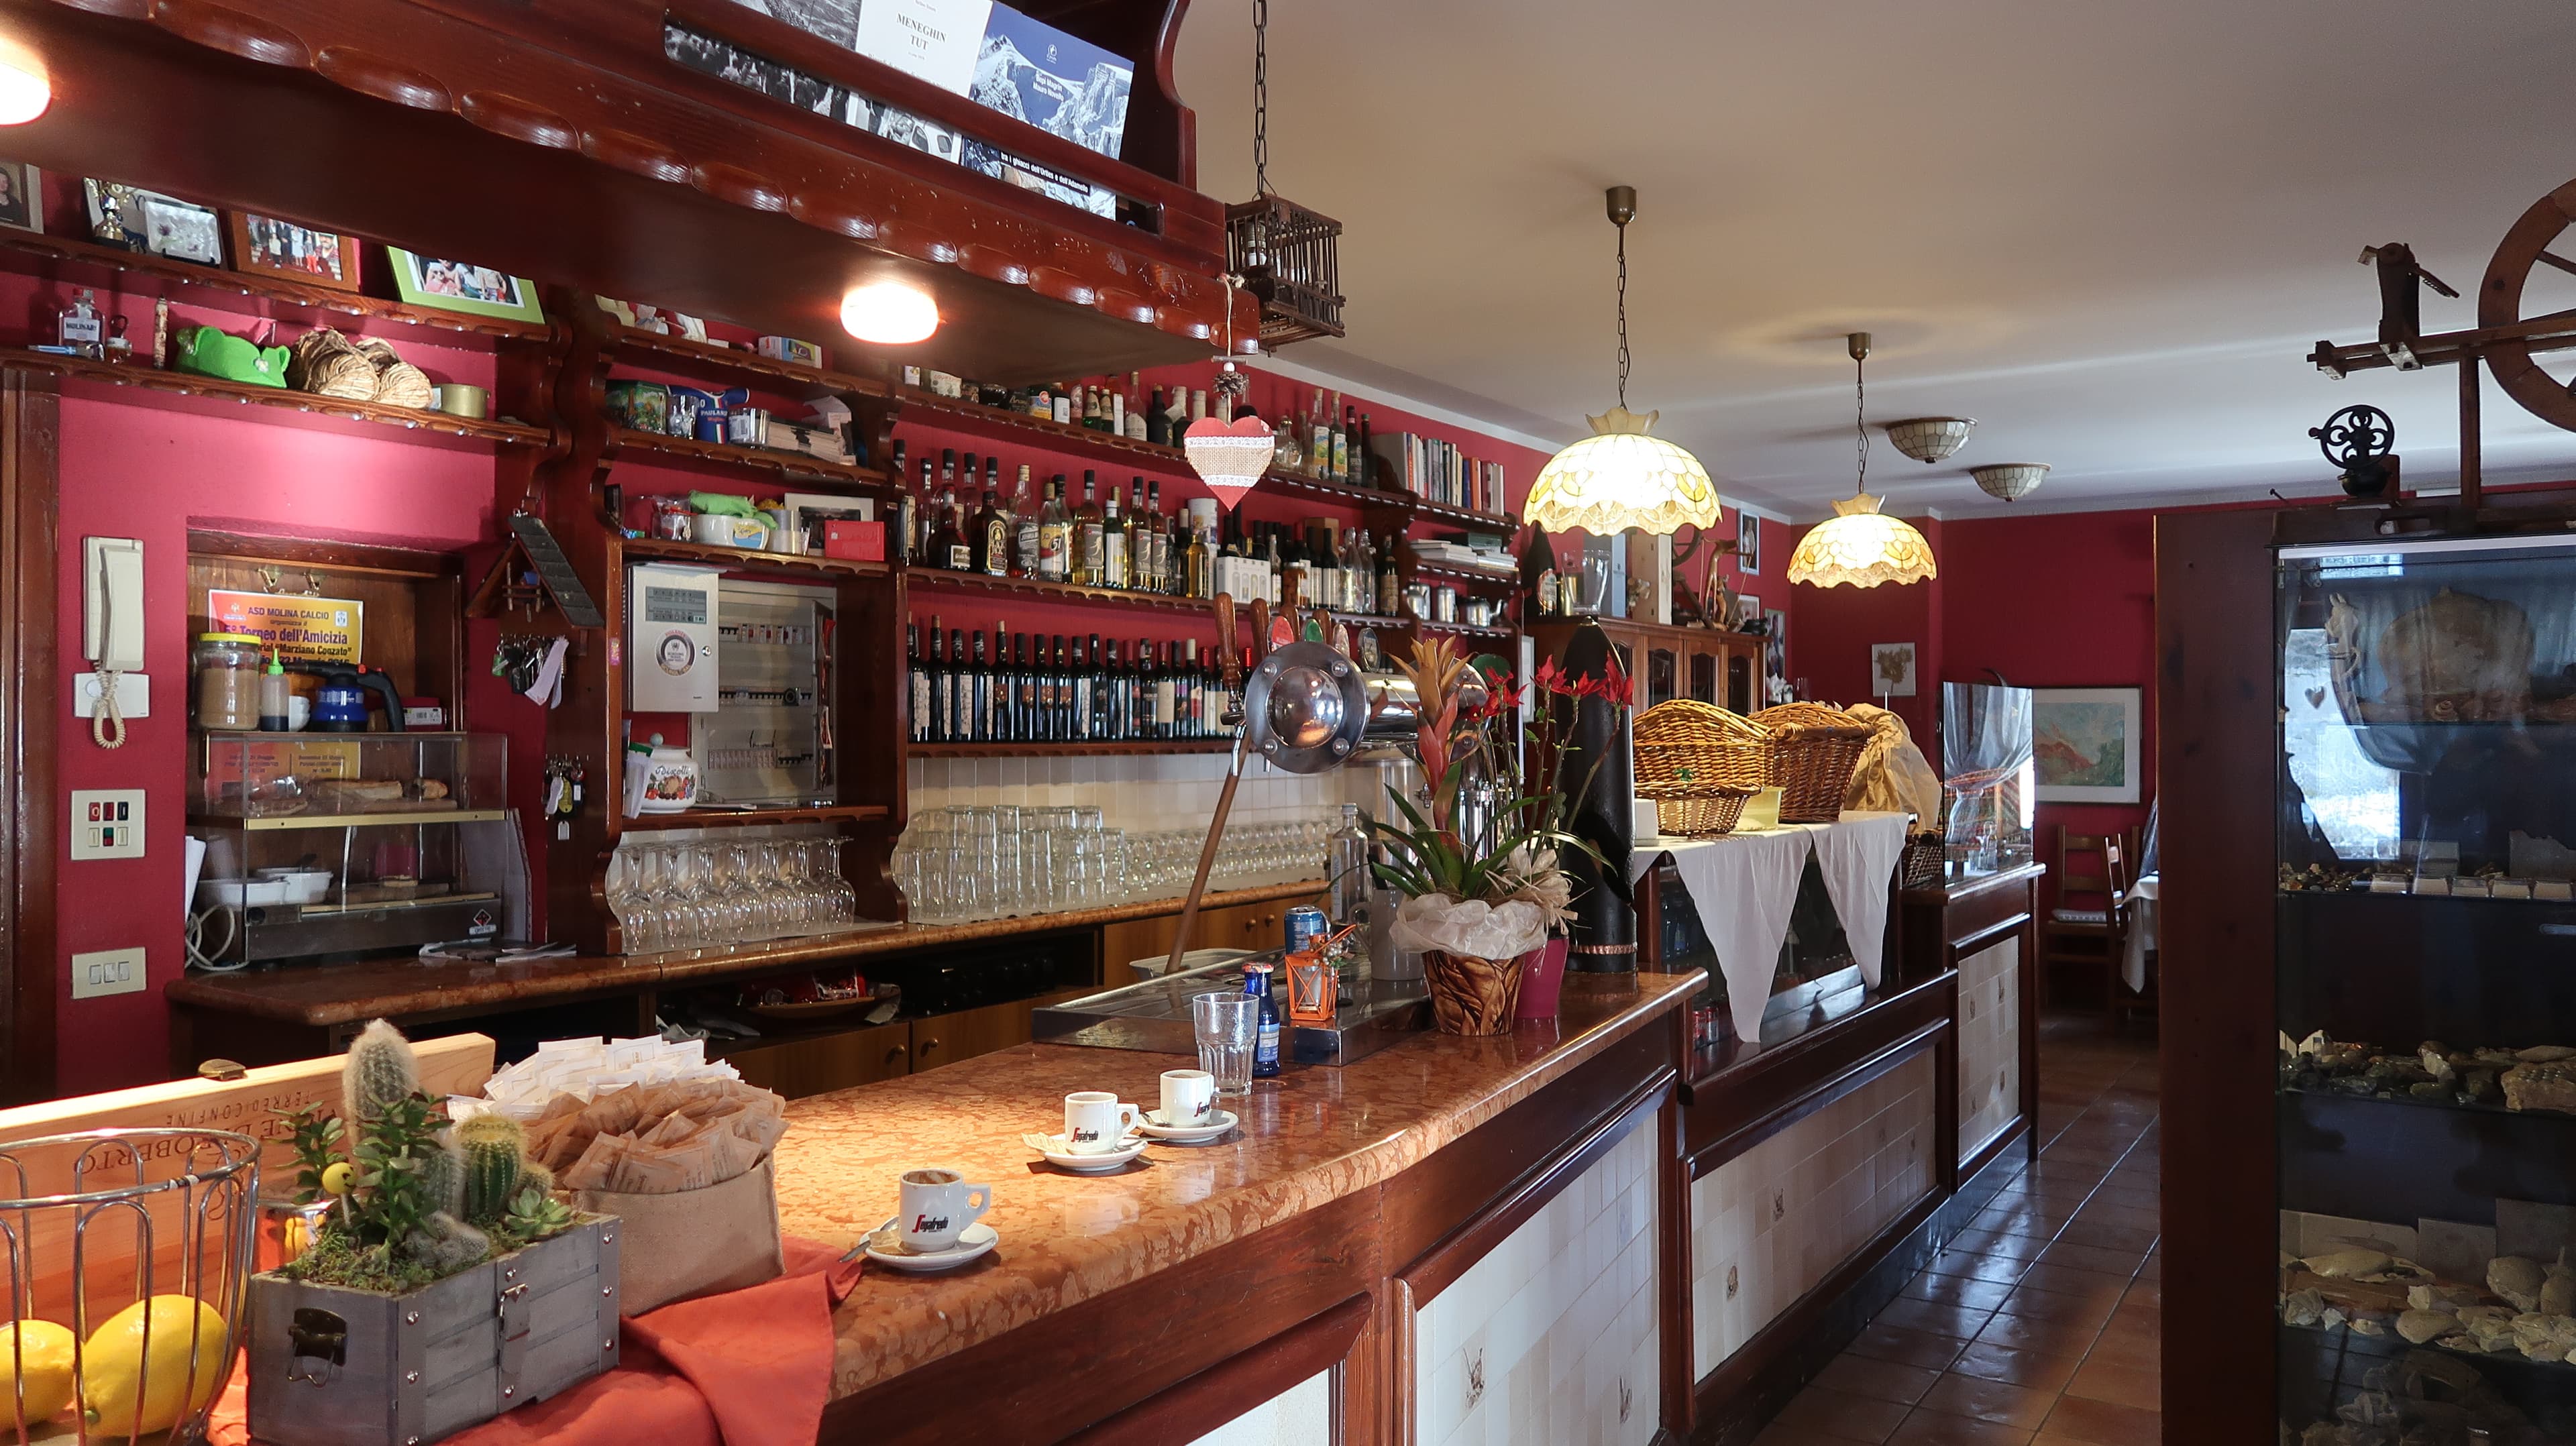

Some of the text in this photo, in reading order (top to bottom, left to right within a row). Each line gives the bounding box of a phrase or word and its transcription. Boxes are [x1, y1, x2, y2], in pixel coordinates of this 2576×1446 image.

[897, 13, 947, 43] MENEGHIN
[910, 34, 928, 50] TUT
[1033, 81, 1065, 102] Mauro Novello
[1046, 76, 1063, 92] Magrin
[1012, 156, 1030, 170] ghiacci
[1059, 175, 1089, 193] dell'Adamello
[248, 607, 329, 620] ASD MOLINA CALCIO
[240, 624, 276, 640] Torneo
[280, 628, 347, 645] dell'Amicizia
